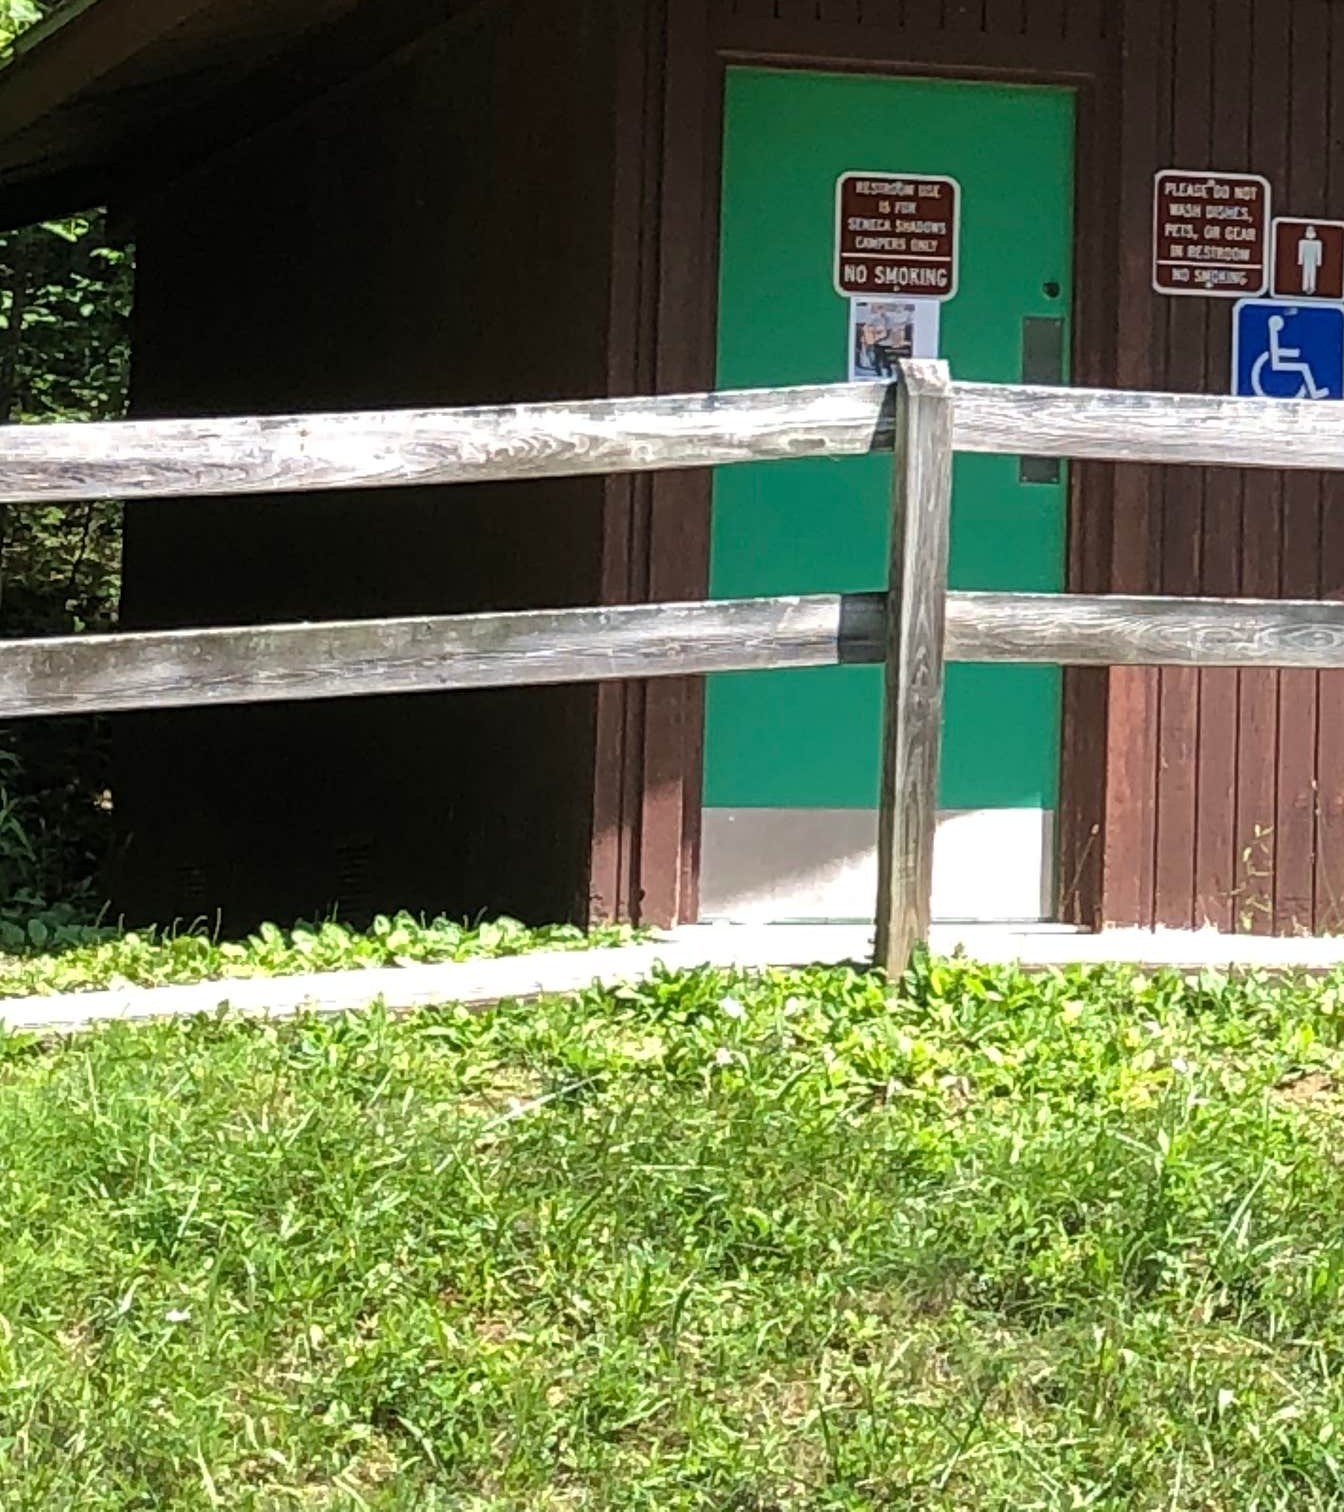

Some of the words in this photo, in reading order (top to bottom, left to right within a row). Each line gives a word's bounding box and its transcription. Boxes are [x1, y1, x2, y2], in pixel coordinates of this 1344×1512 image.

[856, 181, 914, 197] RESTROOM
[919, 185, 941, 198] USE
[1165, 183, 1208, 198] PLEASE
[1213, 186, 1230, 199] DO
[1235, 187, 1257, 200] NOT
[879, 202, 891, 213] IS
[895, 202, 918, 214] FOR
[1170, 204, 1200, 217] WASH
[1206, 206, 1252, 222] DISHES,
[848, 218, 891, 231] SENECA
[896, 220, 946, 234] SHADOWS
[1165, 224, 1198, 239] PETS,
[1204, 226, 1221, 239] OR
[1225, 227, 1256, 241] GEAR
[856, 237, 906, 251] CAMPERS
[911, 239, 938, 252] ONLY
[1170, 245, 1183, 257] IN
[1187, 246, 1250, 261] RESTROOM
[844, 265, 867, 283] NO
[875, 267, 947, 286] SMOKING
[1172, 268, 1189, 280] NO
[1195, 269, 1248, 284] SMOKING
